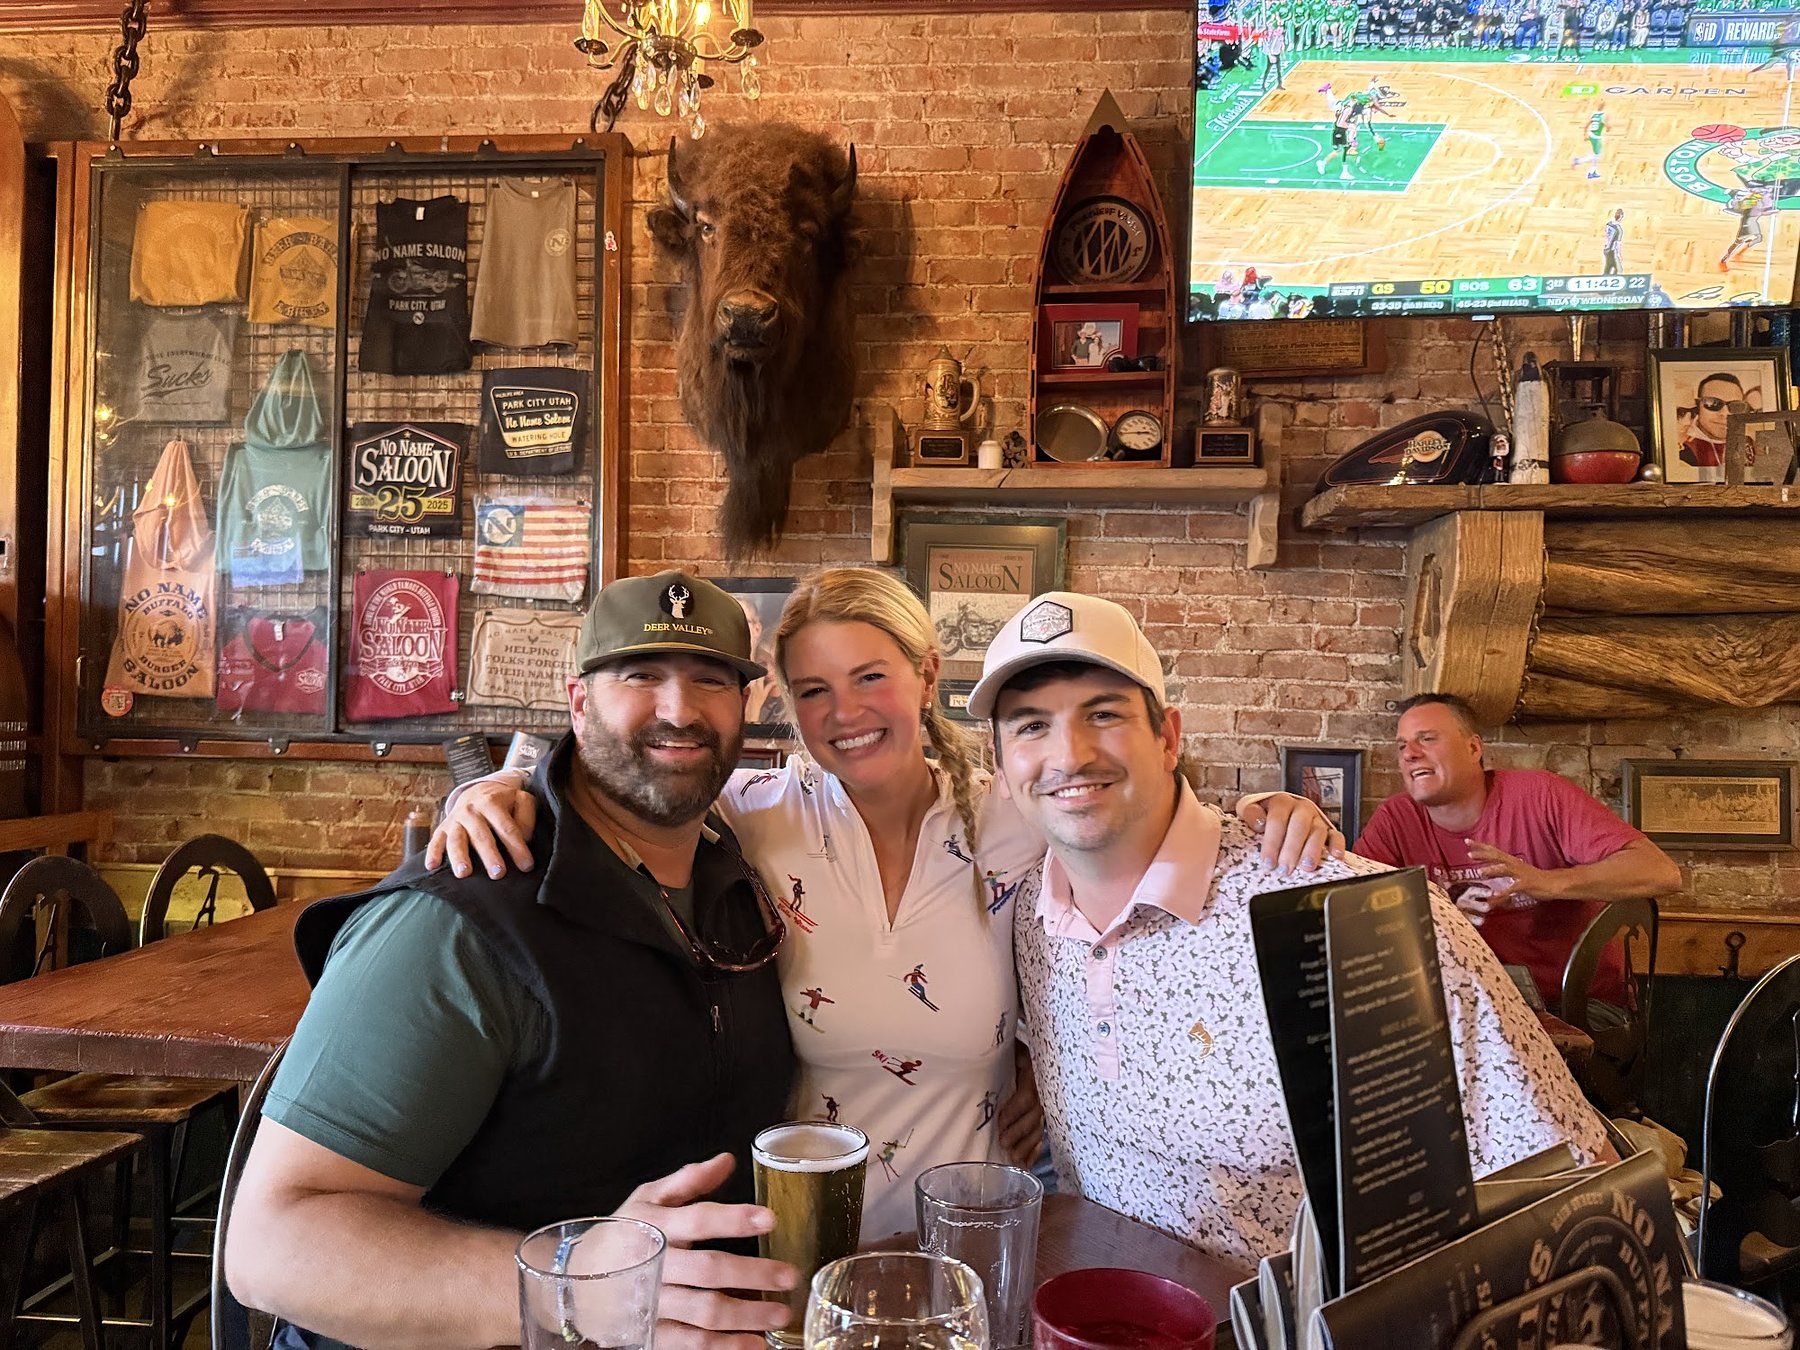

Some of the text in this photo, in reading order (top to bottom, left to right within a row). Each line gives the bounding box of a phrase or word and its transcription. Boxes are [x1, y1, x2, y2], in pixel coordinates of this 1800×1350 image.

[1604, 86, 1746, 95] GARDEN
[1669, 141, 1712, 193] BOSTON
[393, 243, 424, 258] NAME
[426, 243, 466, 263] SALOON
[1371, 280, 1451, 294] GS 50
[1458, 278, 1538, 292] BOS 63
[1575, 278, 1620, 289] 11:42
[1628, 277, 1646, 289] 22
[1547, 295, 1645, 306] NBA WEDNESDAY
[140, 360, 214, 391] Sucks
[502, 397, 571, 410] PARK CITY UTAH
[505, 412, 571, 429] No Name Saloon
[512, 431, 566, 443] WATERING HOLE
[379, 439, 434, 457] NO NAME
[1404, 443, 1451, 456] DAVIDSON
[359, 448, 453, 488] SALOON
[376, 486, 427, 520] 25
[427, 500, 449, 510] 2025
[368, 524, 431, 535] PARK CITY UTAH
[953, 561, 1001, 575] NO NAME
[938, 561, 1024, 591] SALOON
[125, 588, 151, 613] NO
[142, 598, 194, 621] BUFFALO
[643, 623, 670, 632] DEER
[360, 629, 447, 661] SALOON
[504, 645, 559, 657] HELPING
[138, 654, 188, 673] BURGER
[486, 654, 574, 669] FOLKS FORGET
[123, 658, 199, 691] SALOON
[487, 666, 525, 678] THEIR
[871, 1049, 889, 1063] SKI
